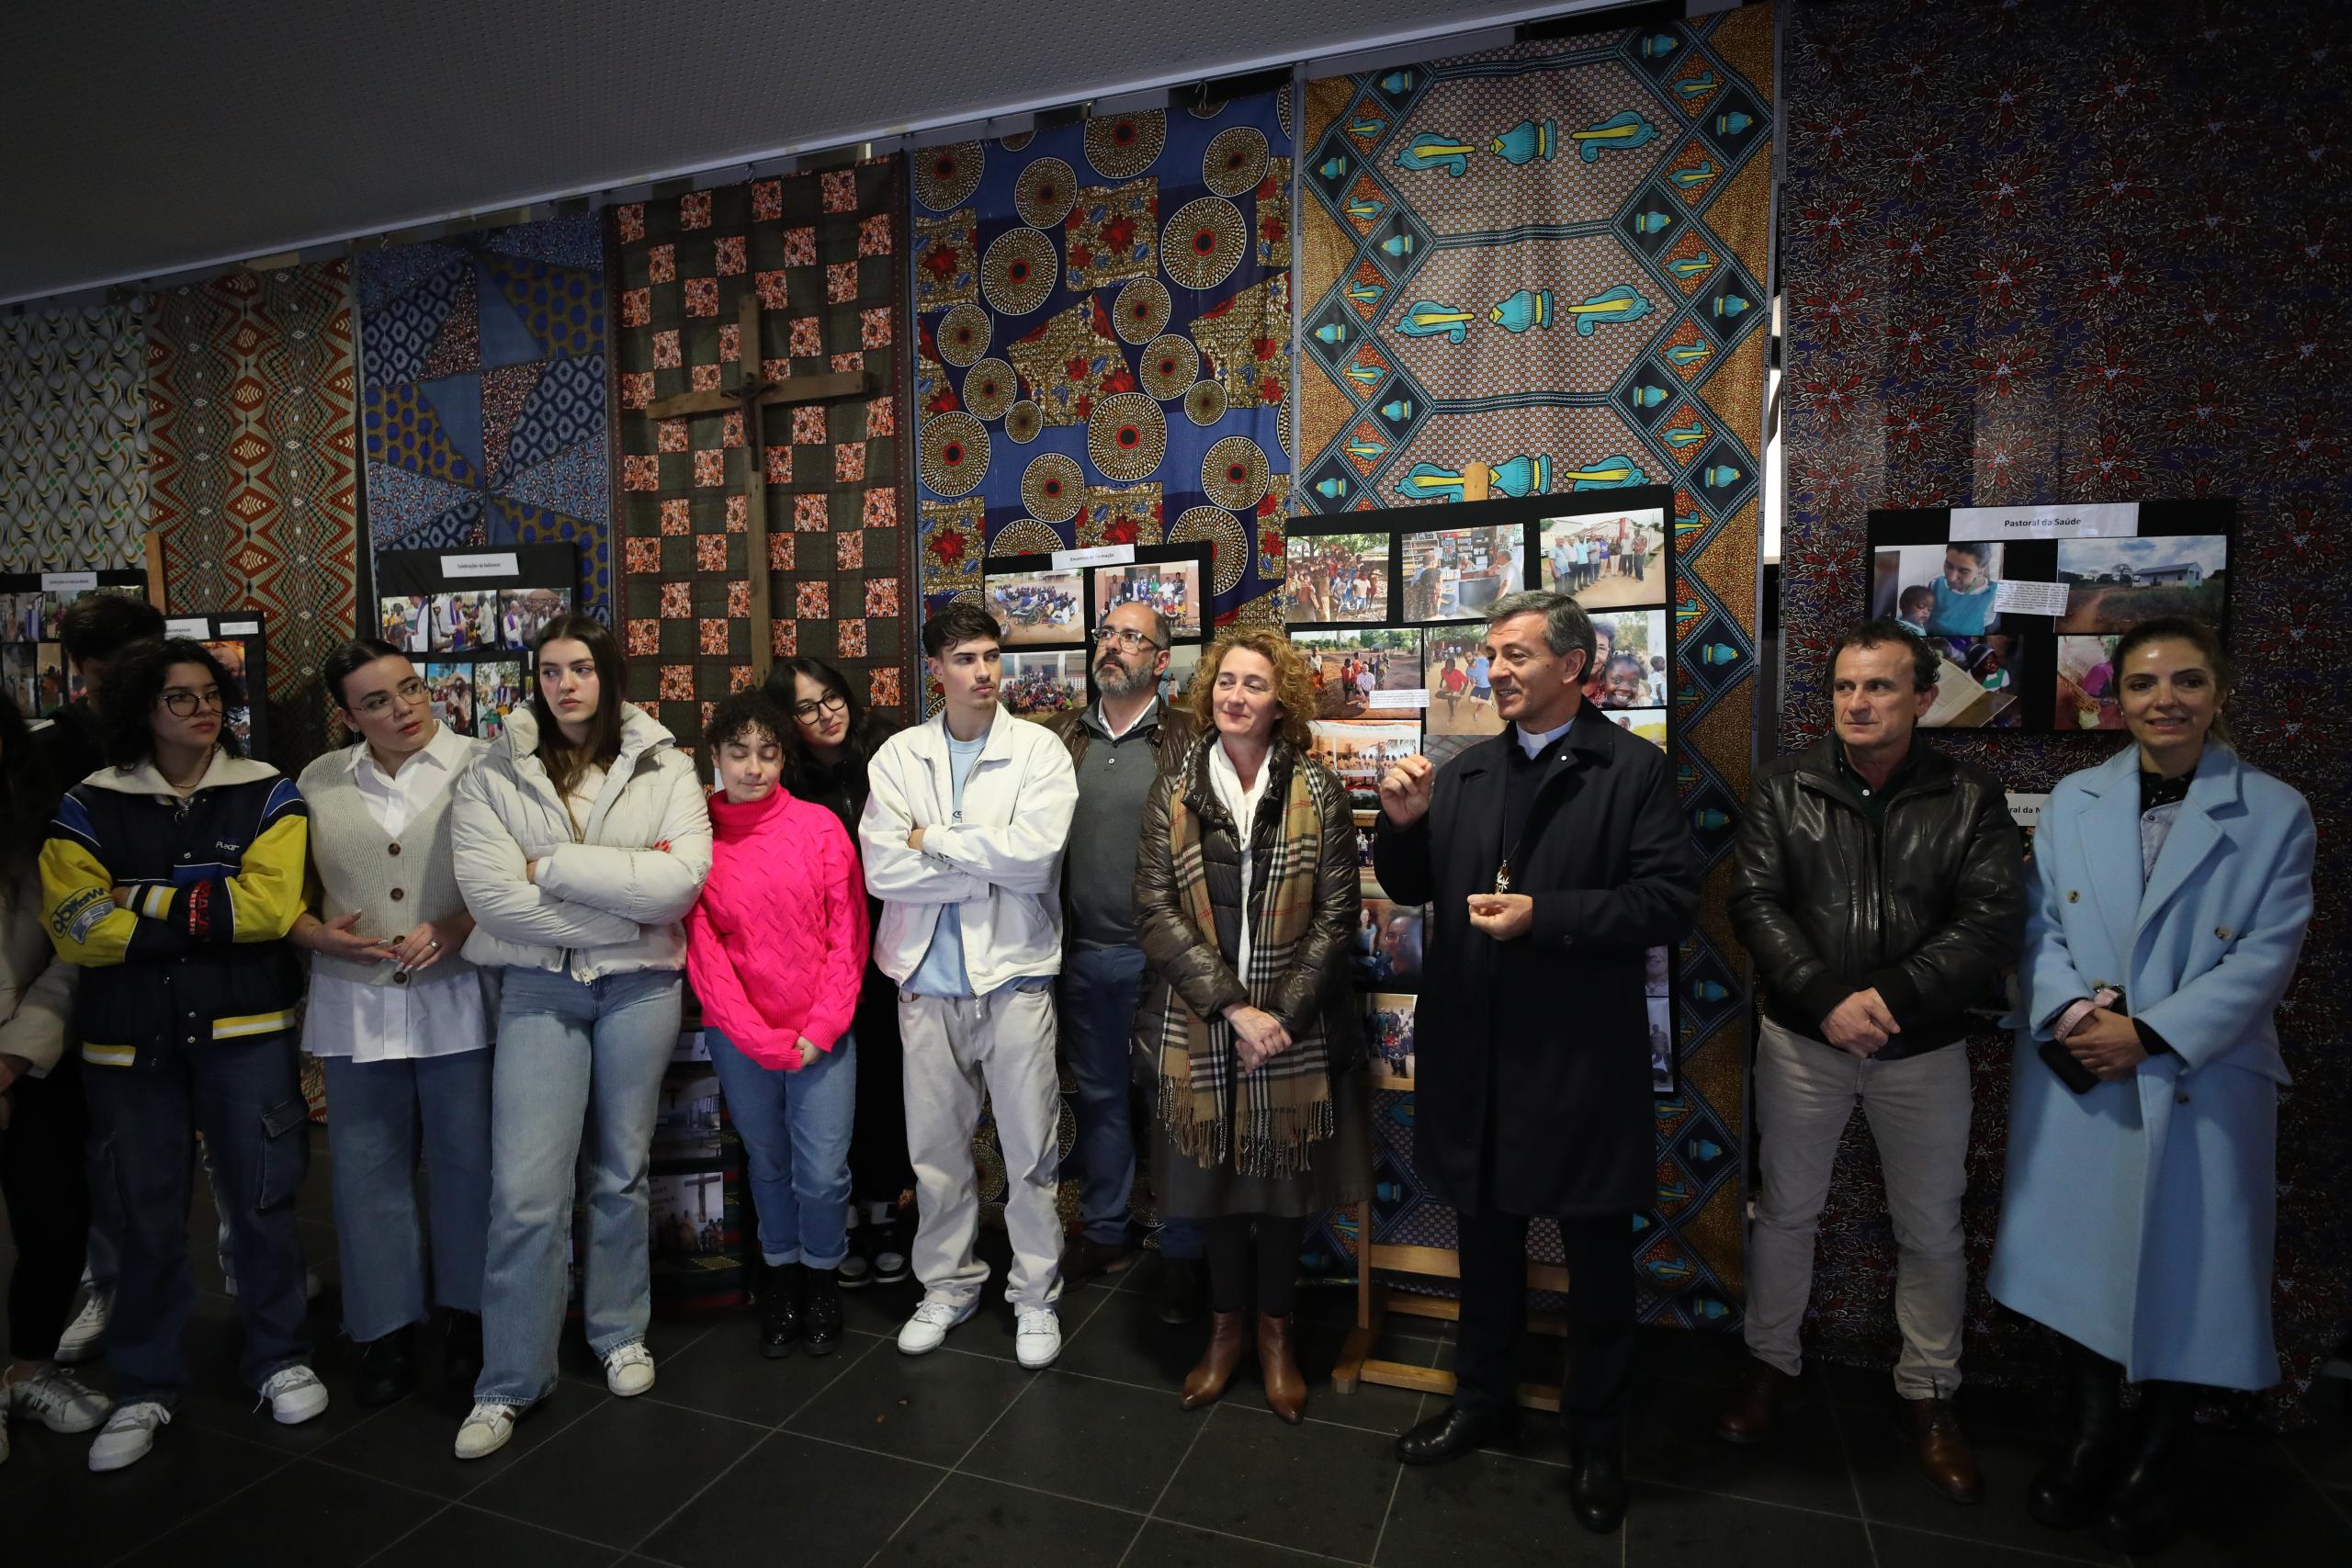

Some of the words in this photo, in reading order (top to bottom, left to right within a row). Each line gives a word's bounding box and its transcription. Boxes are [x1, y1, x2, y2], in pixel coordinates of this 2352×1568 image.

[2004, 519, 2040, 527] Pastoral
[2054, 517, 2081, 526] Saúde
[2022, 806, 2033, 814] da
